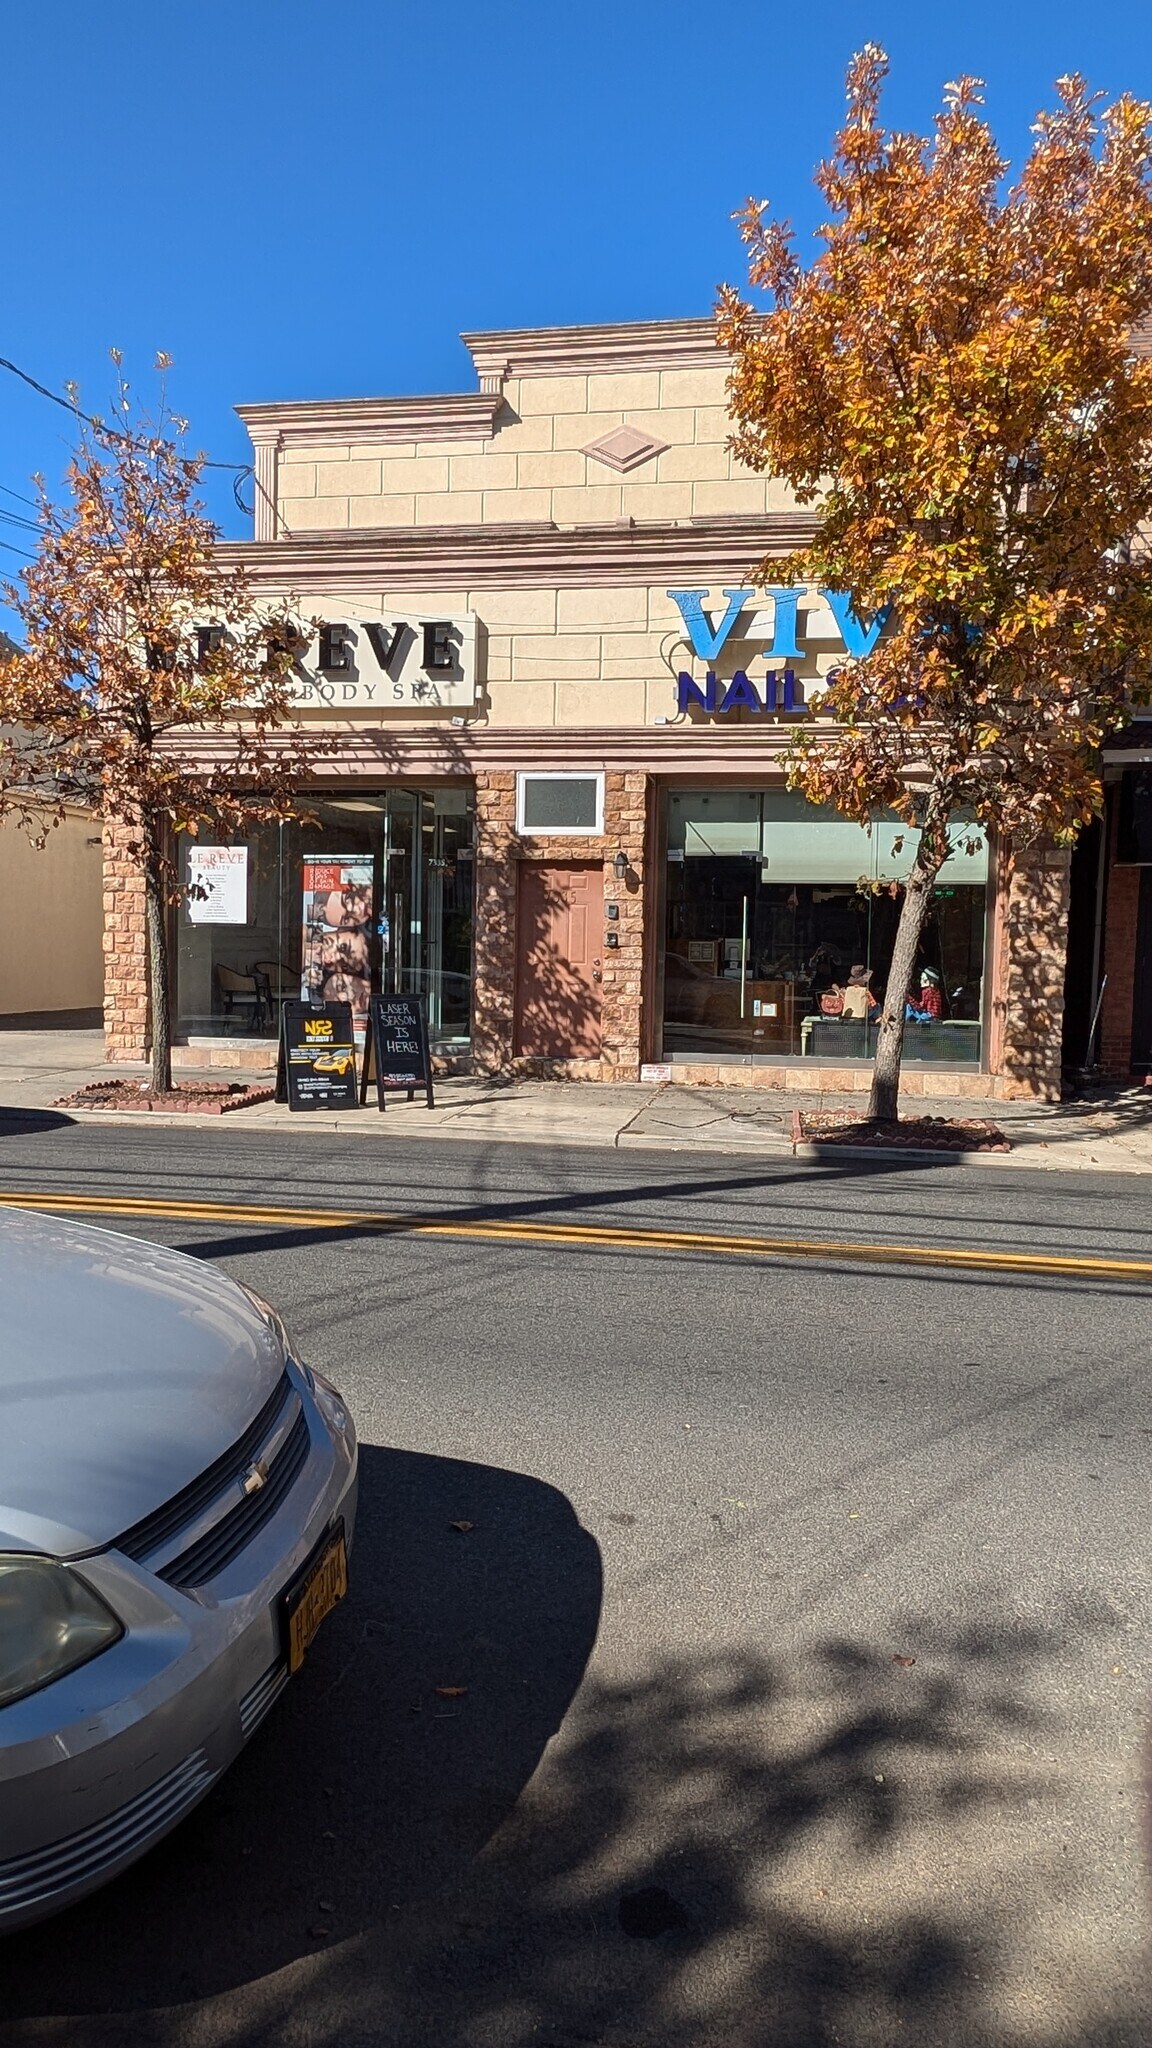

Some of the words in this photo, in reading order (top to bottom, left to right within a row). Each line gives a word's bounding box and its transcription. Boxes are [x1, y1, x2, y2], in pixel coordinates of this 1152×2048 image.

[301, 683, 378, 700] BODY
[393, 683, 442, 700] SPA
[210, 853, 244, 864] REVE
[380, 1002, 411, 1014] LASER
[381, 1015, 417, 1027] SEASON
[394, 1027, 410, 1038] IS
[386, 1040, 420, 1054] HERE!
